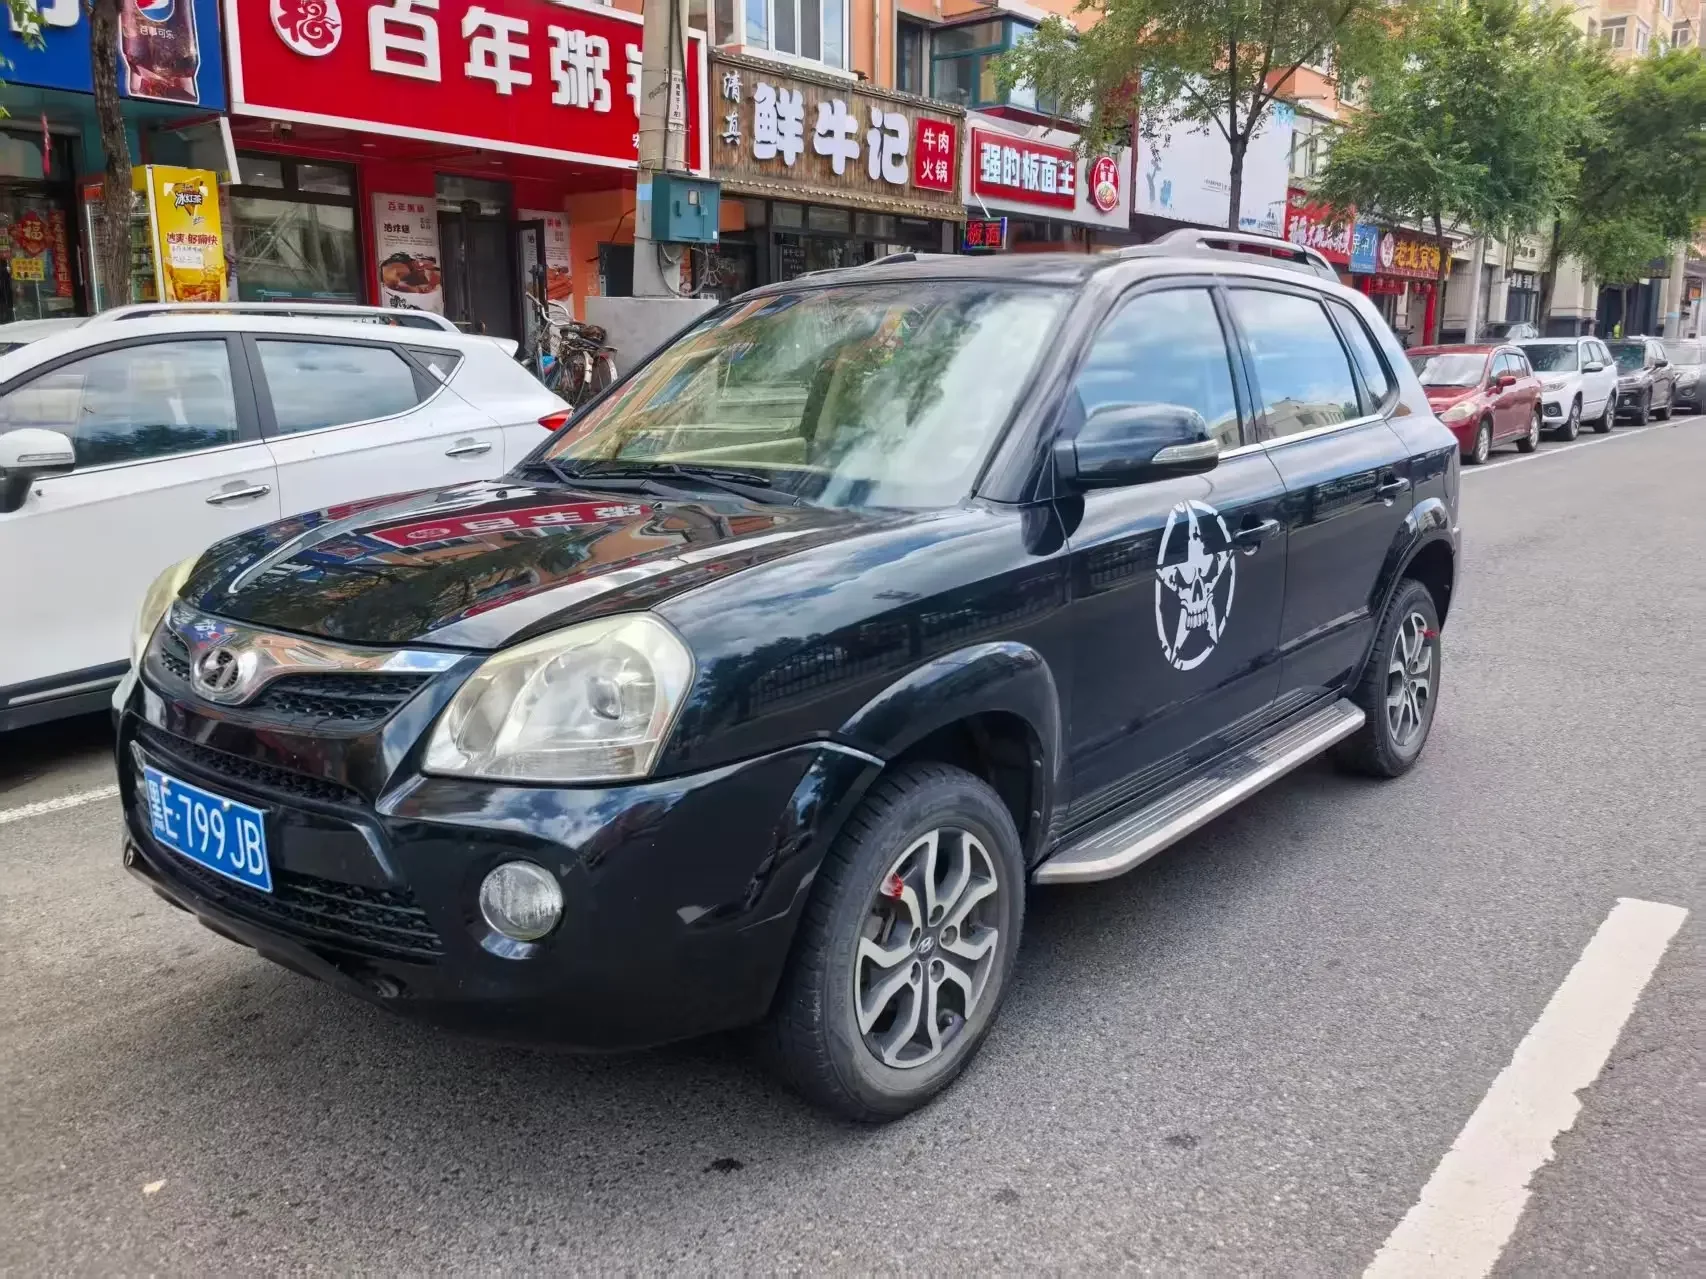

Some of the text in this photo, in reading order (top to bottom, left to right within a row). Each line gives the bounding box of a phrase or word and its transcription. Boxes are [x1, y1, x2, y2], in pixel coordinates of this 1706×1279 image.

[368, 0, 642, 118] 百年粥
[722, 70, 743, 146] 清真
[753, 82, 909, 185] 鲜牛记
[922, 127, 950, 155] 牛肉
[921, 156, 948, 183] 火锅
